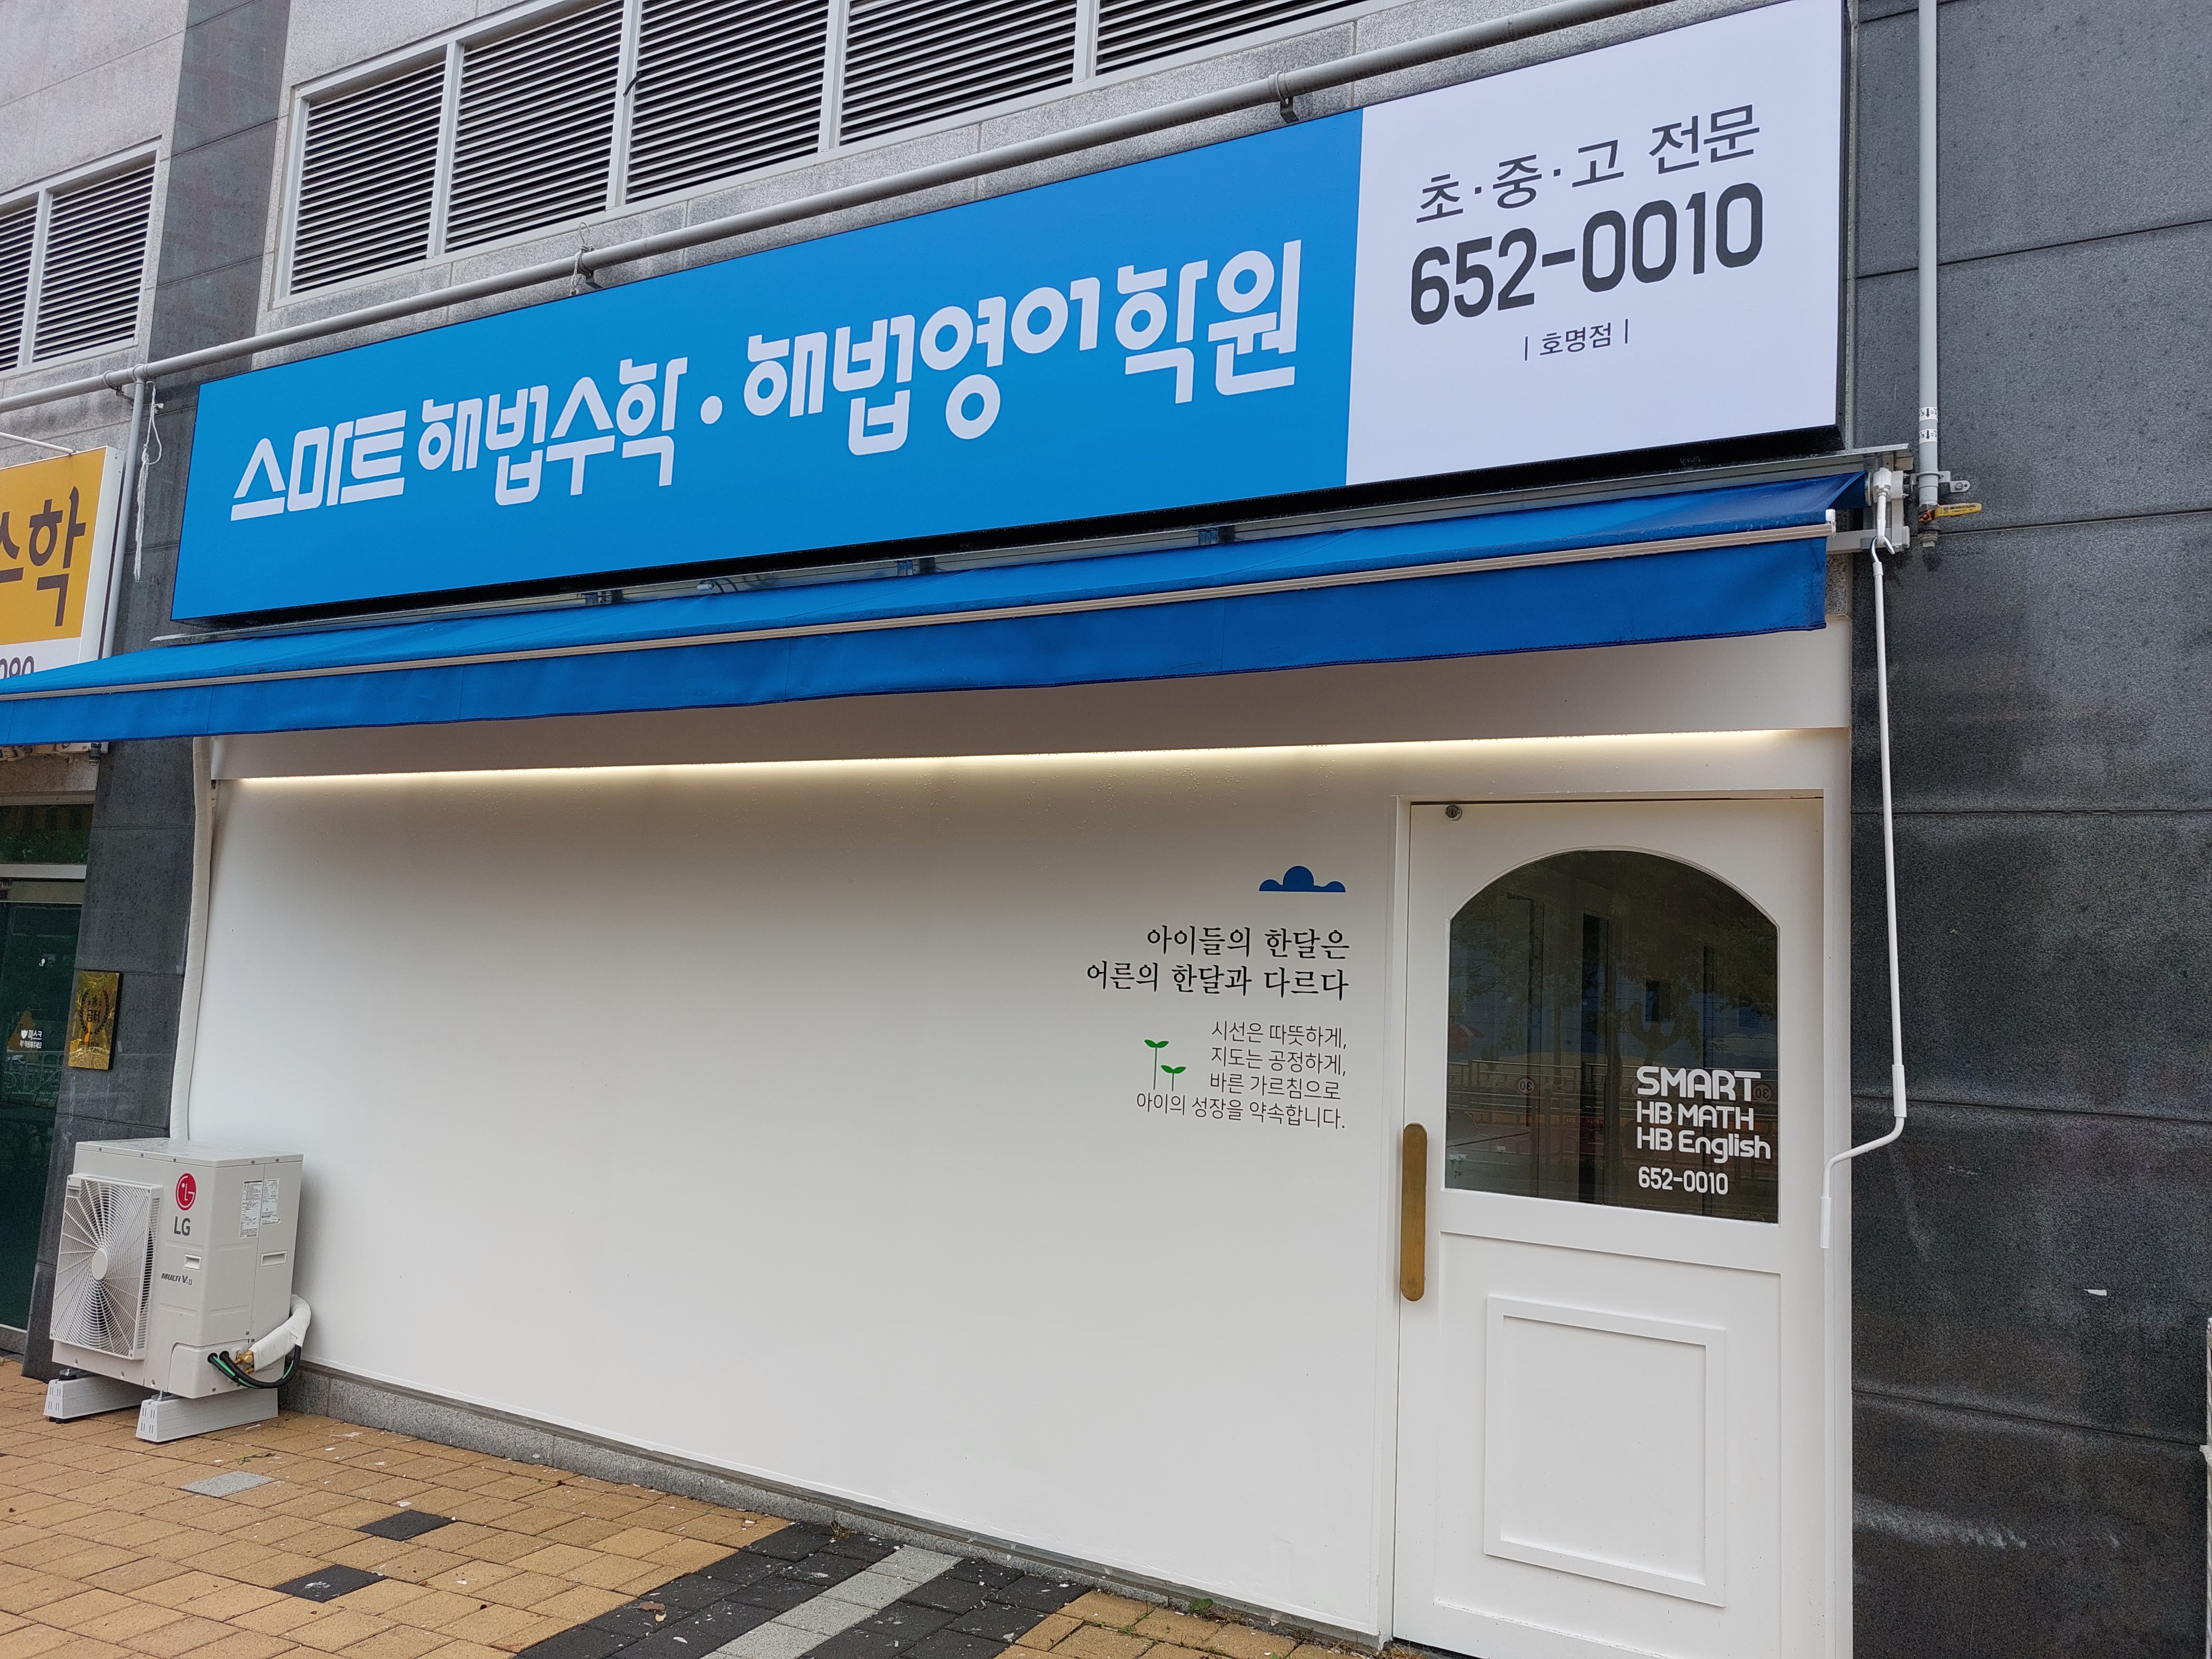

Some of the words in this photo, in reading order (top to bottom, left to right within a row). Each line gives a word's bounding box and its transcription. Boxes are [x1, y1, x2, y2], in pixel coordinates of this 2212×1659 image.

[1649, 104, 1760, 175] 전문
[1411, 182, 1763, 325] 652-0010
[1539, 322, 1612, 356] 호명점
[232, 410, 406, 521] 스마트
[419, 357, 687, 506] 해법수학
[744, 240, 1301, 455] 해법영어학원
[1147, 925, 1250, 958] 아이들의
[1264, 928, 1350, 959] 한달은
[1087, 960, 1158, 993] 어른의
[1171, 963, 1252, 996] 한달과
[1263, 967, 1349, 1001] 다르다
[28, 1030, 42, 1040] 마스크
[1211, 1020, 1264, 1043] 시선은
[1270, 1024, 1347, 1050] 따뜻하게,
[1211, 1046, 1263, 1070] 지도는
[1268, 1050, 1347, 1077] 공정하게,
[1210, 1072, 1244, 1095] 바른
[1250, 1075, 1341, 1100] 가르침으로
[1637, 1066, 1761, 1102] SMART
[1136, 1092, 1186, 1116] 아이의
[1191, 1097, 1244, 1121] 성장을
[1249, 1101, 1345, 1130] 약속합니다.
[1637, 1100, 1672, 1125] HB
[1678, 1103, 1754, 1130] MATH
[1637, 1127, 1673, 1151] HB
[1679, 1130, 1771, 1163] English
[1638, 1166, 1728, 1195] 652-0010
[174, 1216, 191, 1236] LG
[161, 1273, 181, 1283] MULTI
